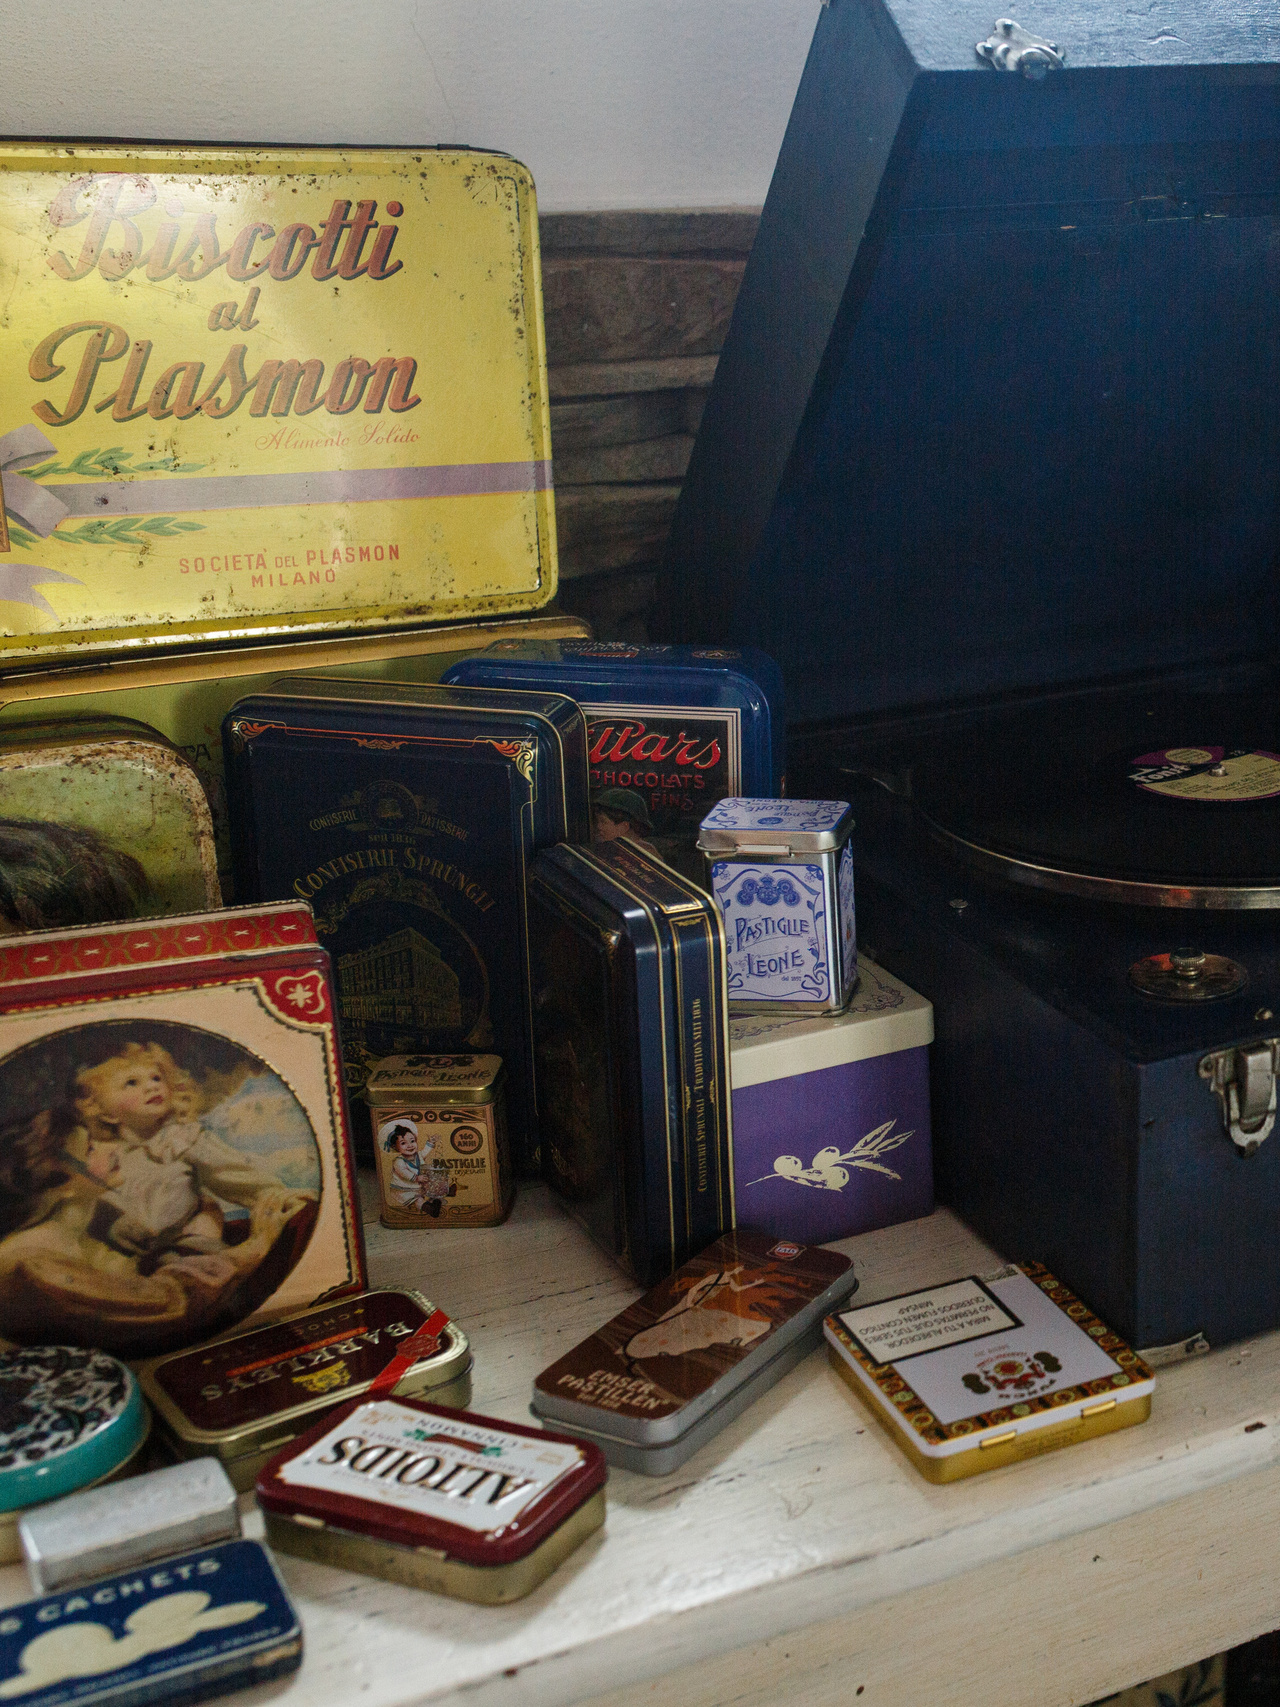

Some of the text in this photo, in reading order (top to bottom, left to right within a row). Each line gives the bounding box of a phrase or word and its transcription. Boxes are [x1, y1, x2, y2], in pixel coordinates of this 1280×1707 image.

[46, 171, 404, 282] Biscotti
[208, 286, 261, 331] al
[28, 320, 422, 427] Plasmon
[255, 421, 421, 451] Alimento Solido
[274, 554, 299, 570] DEL
[306, 543, 400, 566] PLASMON
[251, 568, 337, 589] MILANO
[308, 809, 358, 832] CONFISERIE
[292, 847, 496, 913] CONFISERIE SPRÜNGLI
[735, 916, 810, 952] PASTIGLIE
[746, 949, 805, 977] LEONE
[693, 1042, 704, 1091] TRADITION
[457, 1140, 477, 1148] ANNI
[459, 1132, 473, 1140] 160
[433, 1157, 486, 1169] PASTIGLIE
[201, 1320, 415, 1401] BARKLEYS
[557, 1374, 661, 1410] PASTILLEN
[587, 1369, 656, 1394] EMSER
[415, 1418, 520, 1450] CINNAMON
[317, 1436, 538, 1506] ALTOIDS
[35, 1557, 222, 1623] CACHETS
